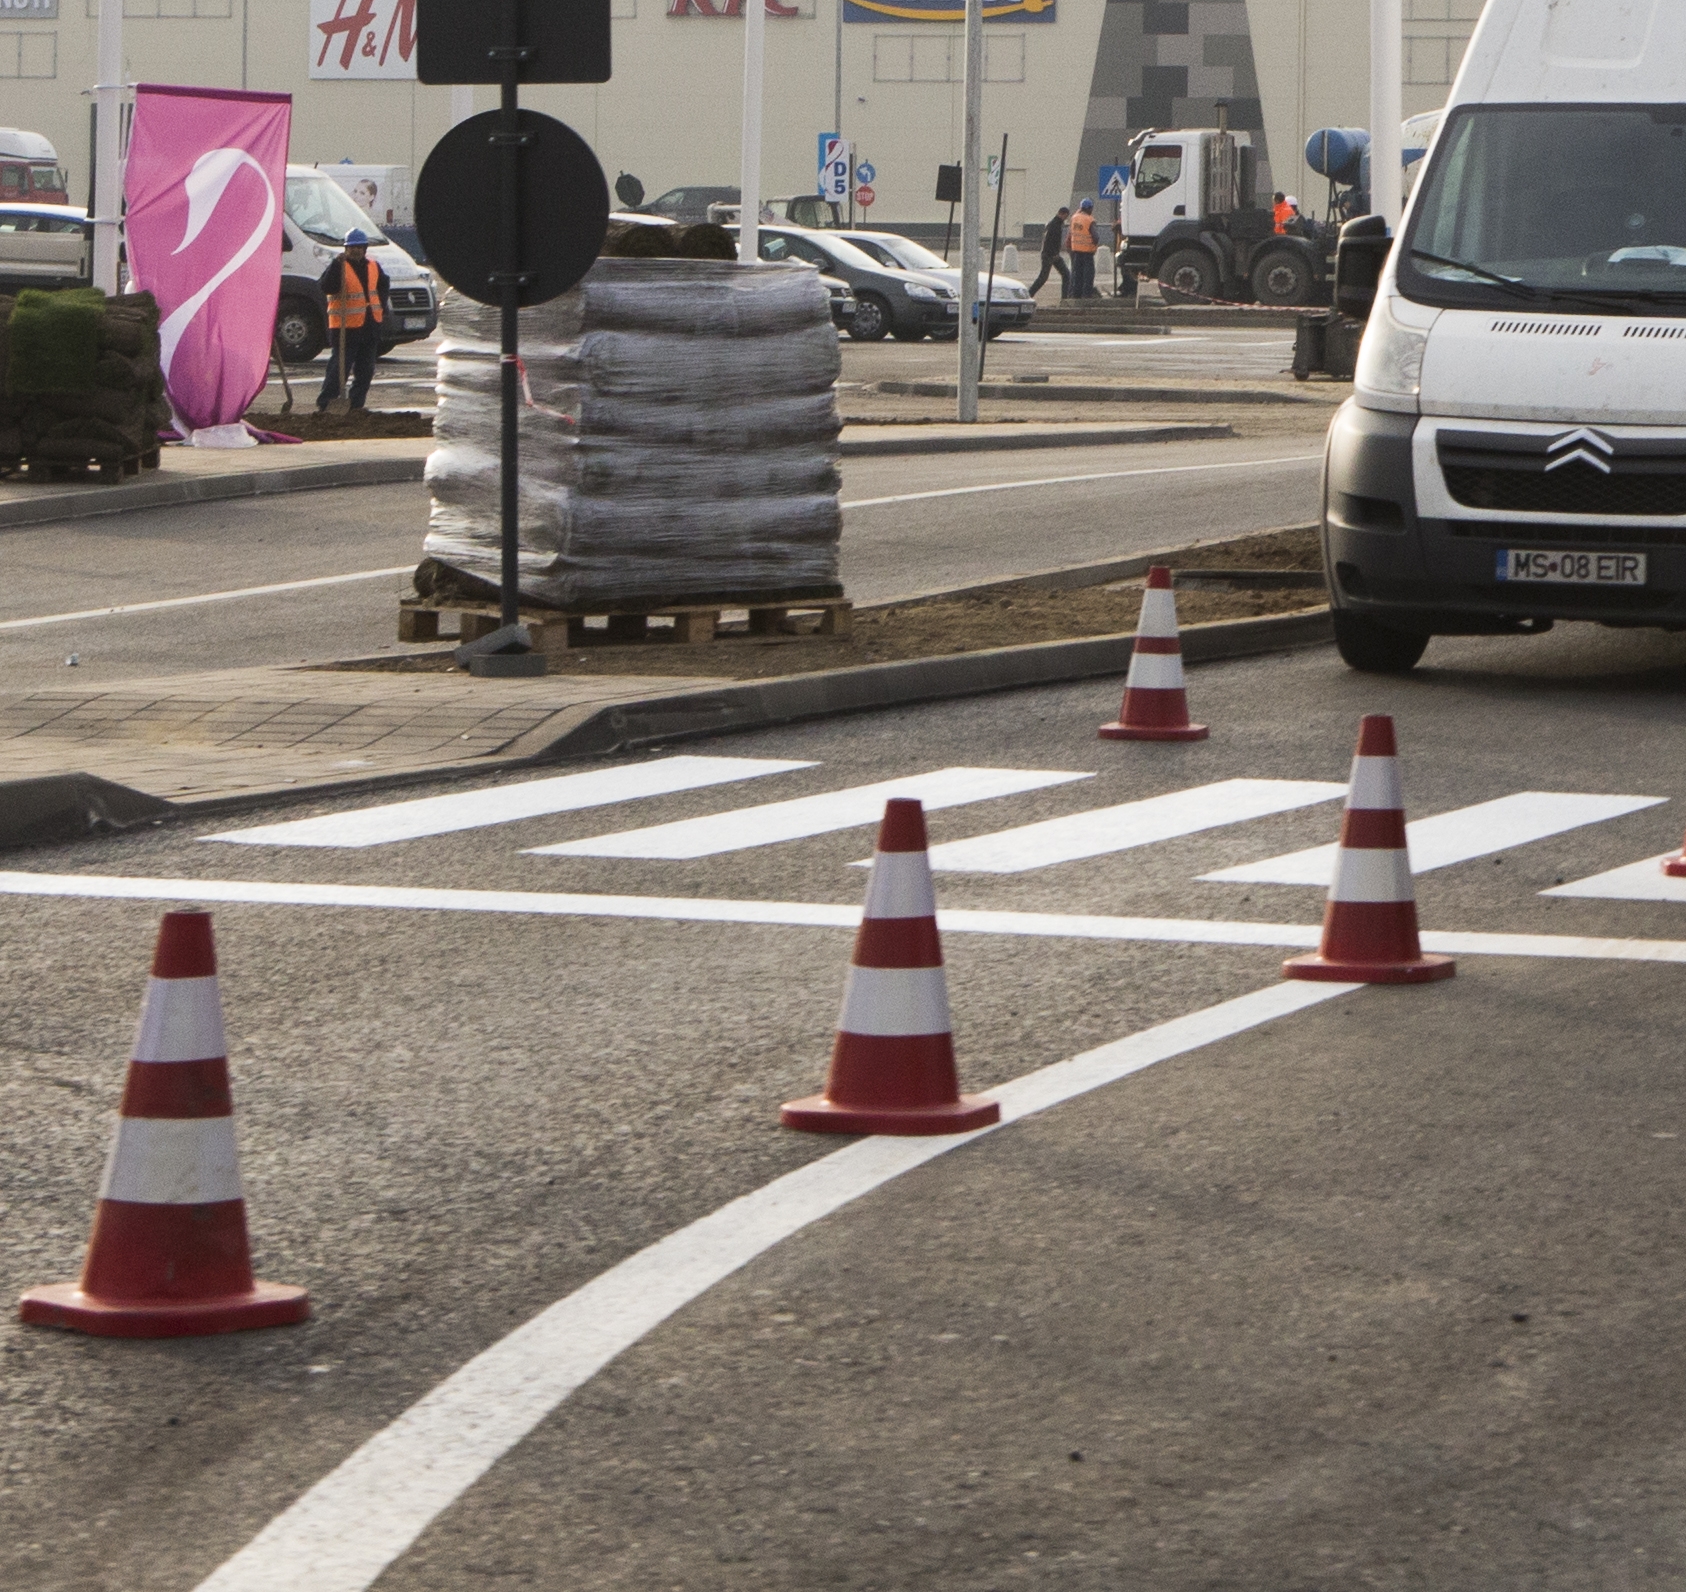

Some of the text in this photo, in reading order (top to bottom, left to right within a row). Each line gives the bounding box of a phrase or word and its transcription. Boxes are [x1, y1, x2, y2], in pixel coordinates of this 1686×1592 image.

[834, 161, 846, 176] D
[834, 179, 846, 194] 5
[1560, 554, 1590, 579] 08
[1597, 555, 1639, 581] EIR
